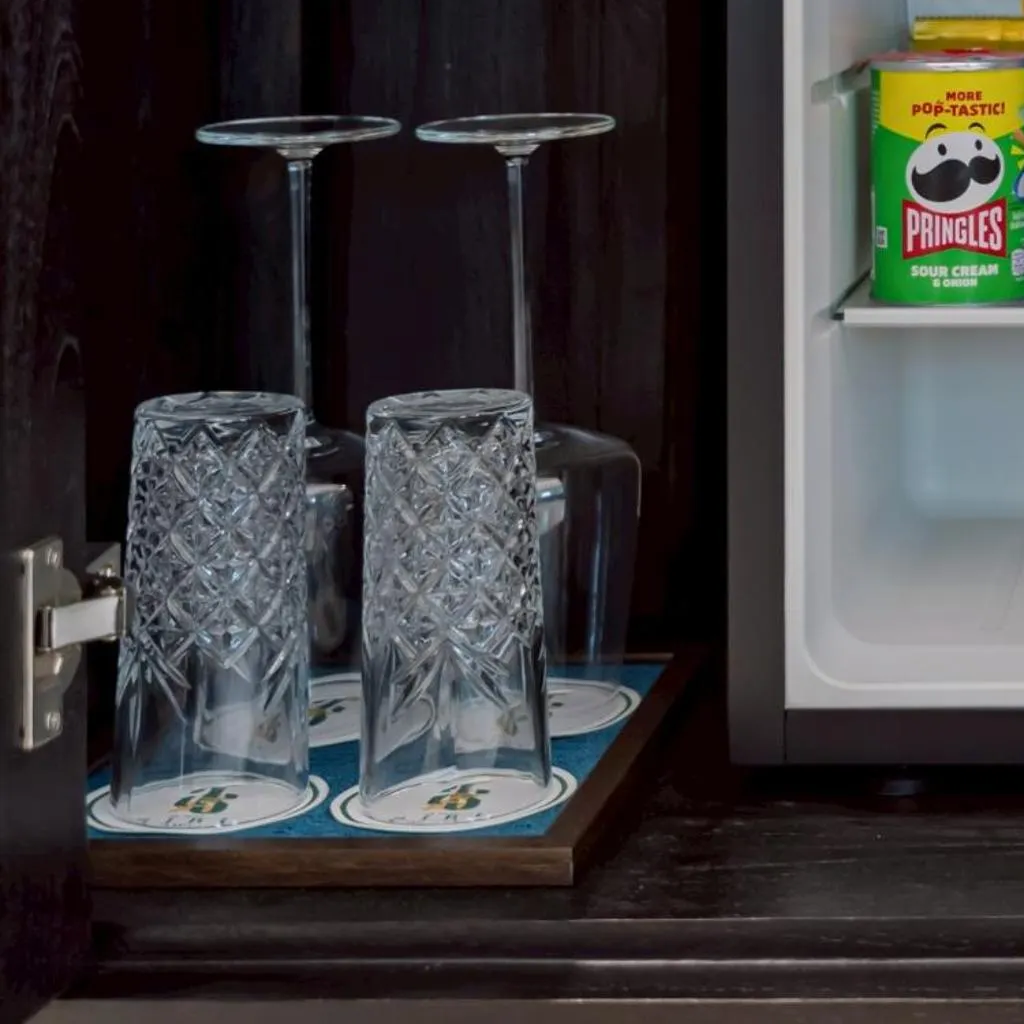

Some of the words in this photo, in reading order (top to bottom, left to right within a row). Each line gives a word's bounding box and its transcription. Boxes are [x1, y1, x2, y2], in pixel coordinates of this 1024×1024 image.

[945, 90, 983, 101] MORE
[906, 205, 1003, 253] PRINGLES
[911, 264, 949, 278] SOUR
[951, 262, 999, 277] CREAM
[942, 277, 978, 288] ONION
